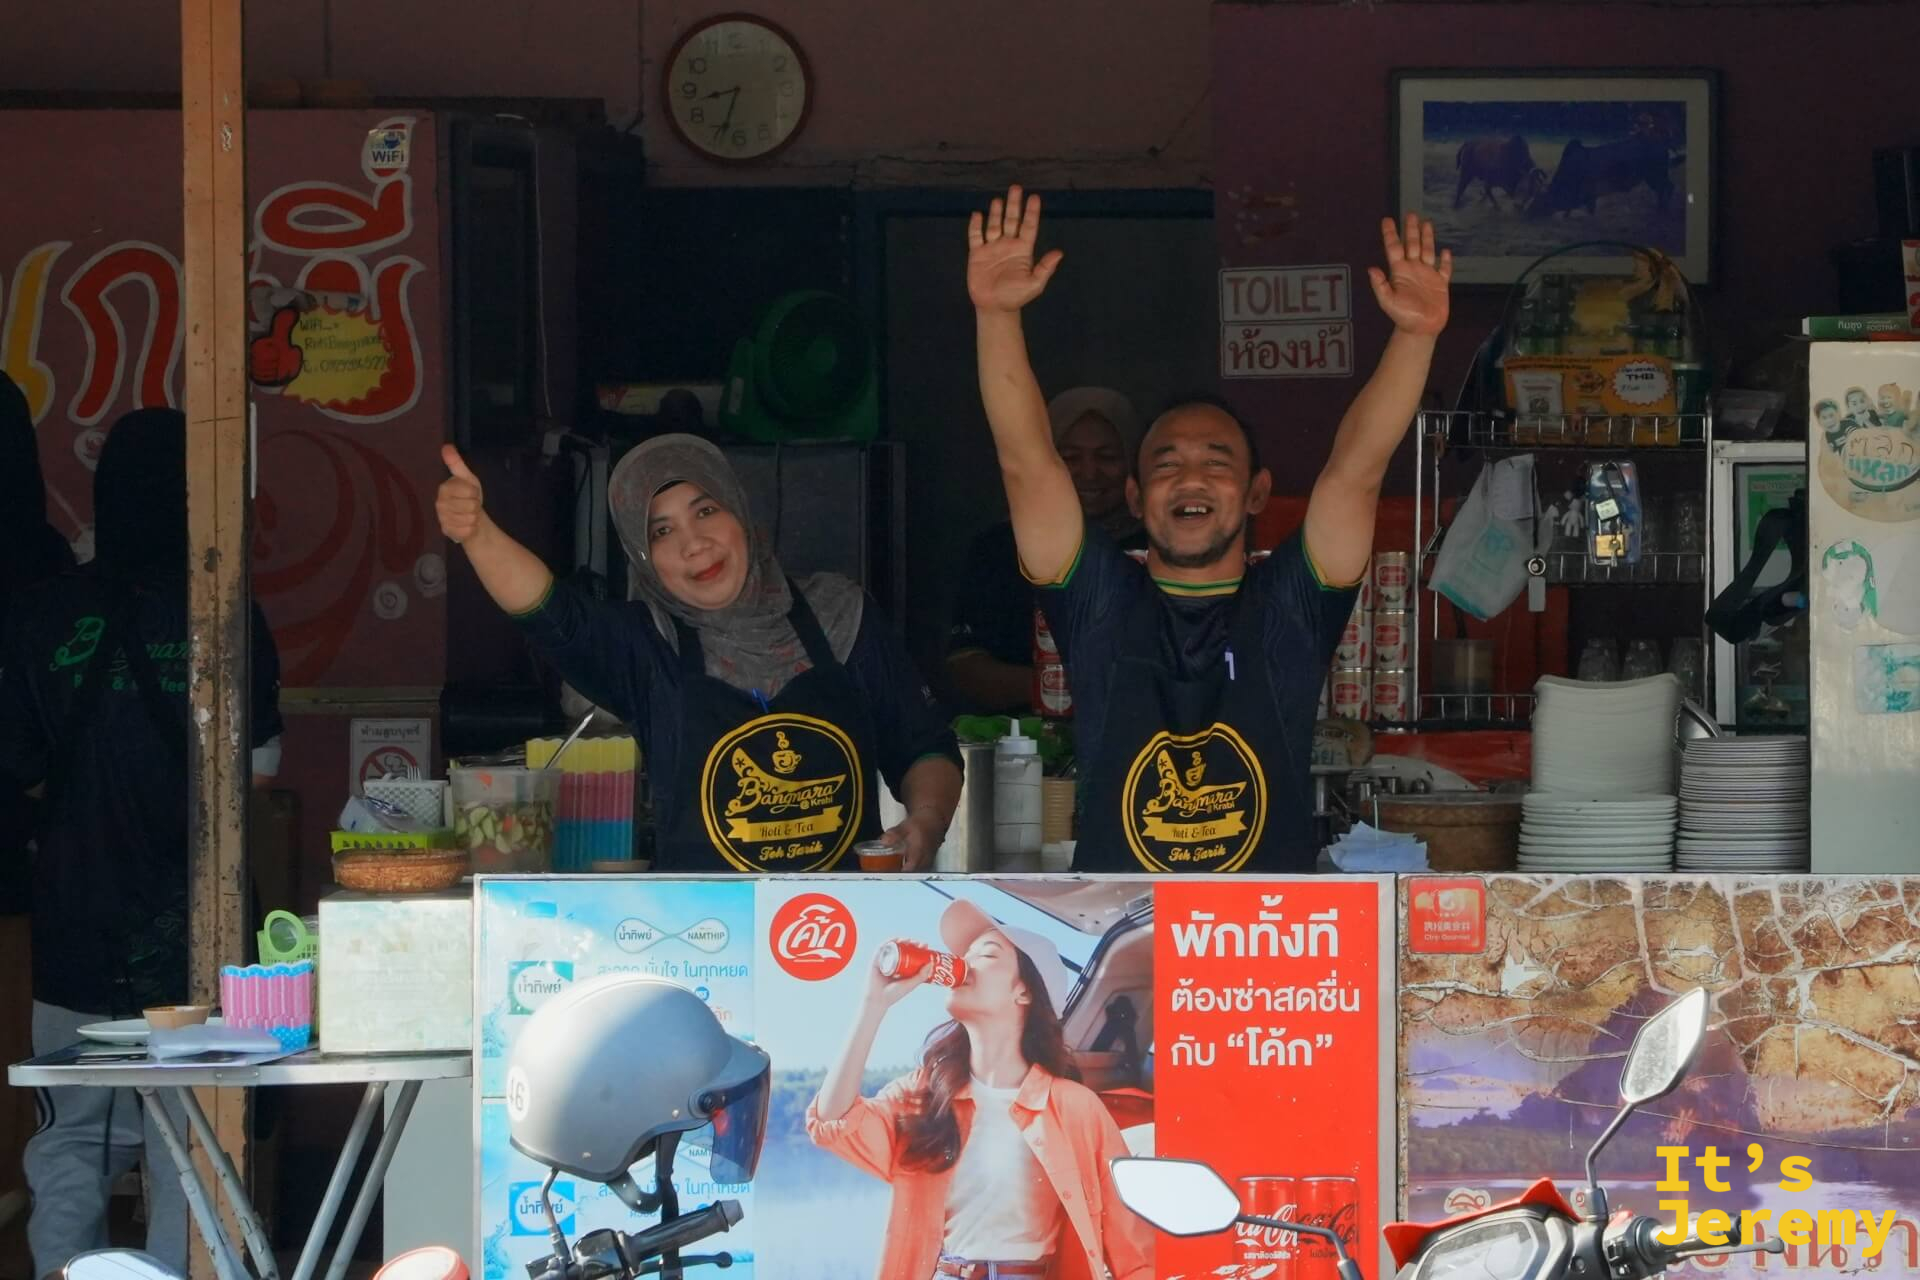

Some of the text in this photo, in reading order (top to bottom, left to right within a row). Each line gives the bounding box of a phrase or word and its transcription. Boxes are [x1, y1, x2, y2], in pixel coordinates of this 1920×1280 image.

[688, 57, 706, 74] 10
[682, 82, 697, 99] 9
[691, 107, 704, 123] 8
[732, 131, 746, 145] 6
[372, 151, 404, 162] WiFi
[1226, 273, 1343, 315] TOILET
[1228, 326, 1345, 370] ห้องน้ำ
[725, 776, 836, 817] Bangnara
[794, 822, 814, 834] Tea
[1201, 826, 1216, 837] Tea
[619, 926, 654, 941] น้ำทิพย์
[777, 903, 847, 961] โค้ก
[1170, 894, 1339, 958] พักทั้งที
[688, 931, 726, 941] NAMTHIP
[683, 960, 749, 982] ในทุกหยด
[1171, 969, 1360, 1012] ต้องซ่าสดชื่น
[1170, 1026, 1333, 1066] กับ “โค้ก”
[520, 1198, 565, 1215] น้ำทิย์
